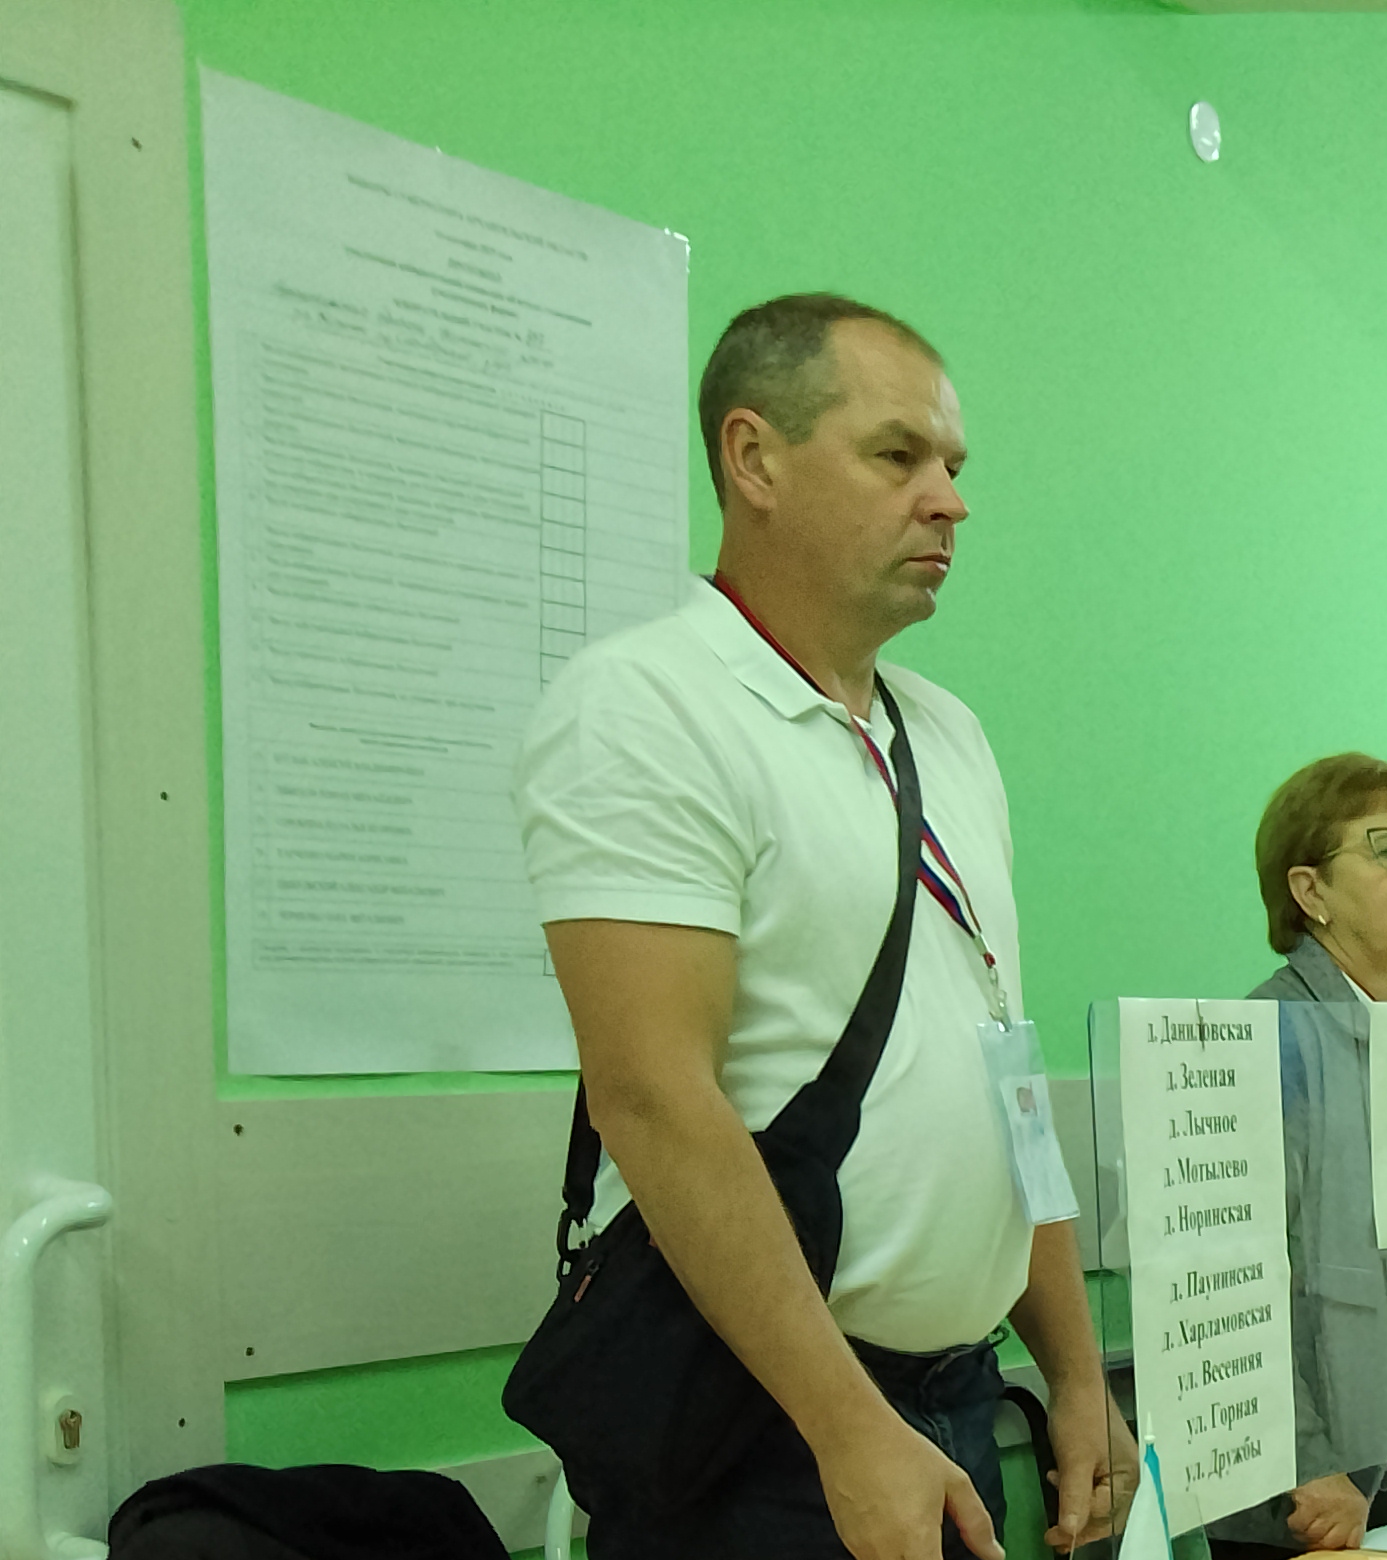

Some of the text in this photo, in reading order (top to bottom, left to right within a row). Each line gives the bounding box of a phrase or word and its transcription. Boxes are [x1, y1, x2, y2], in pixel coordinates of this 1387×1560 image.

[1147, 1022, 1158, 1044] д.
[1166, 1062, 1236, 1092] д. Зеленая
[1168, 1110, 1238, 1140] д. Лычное
[1163, 1157, 1248, 1188] д. Мотылево
[1164, 1203, 1252, 1237] д. Норинская
[1170, 1262, 1264, 1304] д. Паунинская
[1162, 1303, 1272, 1354] д. Харламовская
[1178, 1352, 1263, 1401] ул. Весенняя
[1187, 1397, 1258, 1444] ул. Горная
[1186, 1436, 1262, 1492] ул. Дружбы
